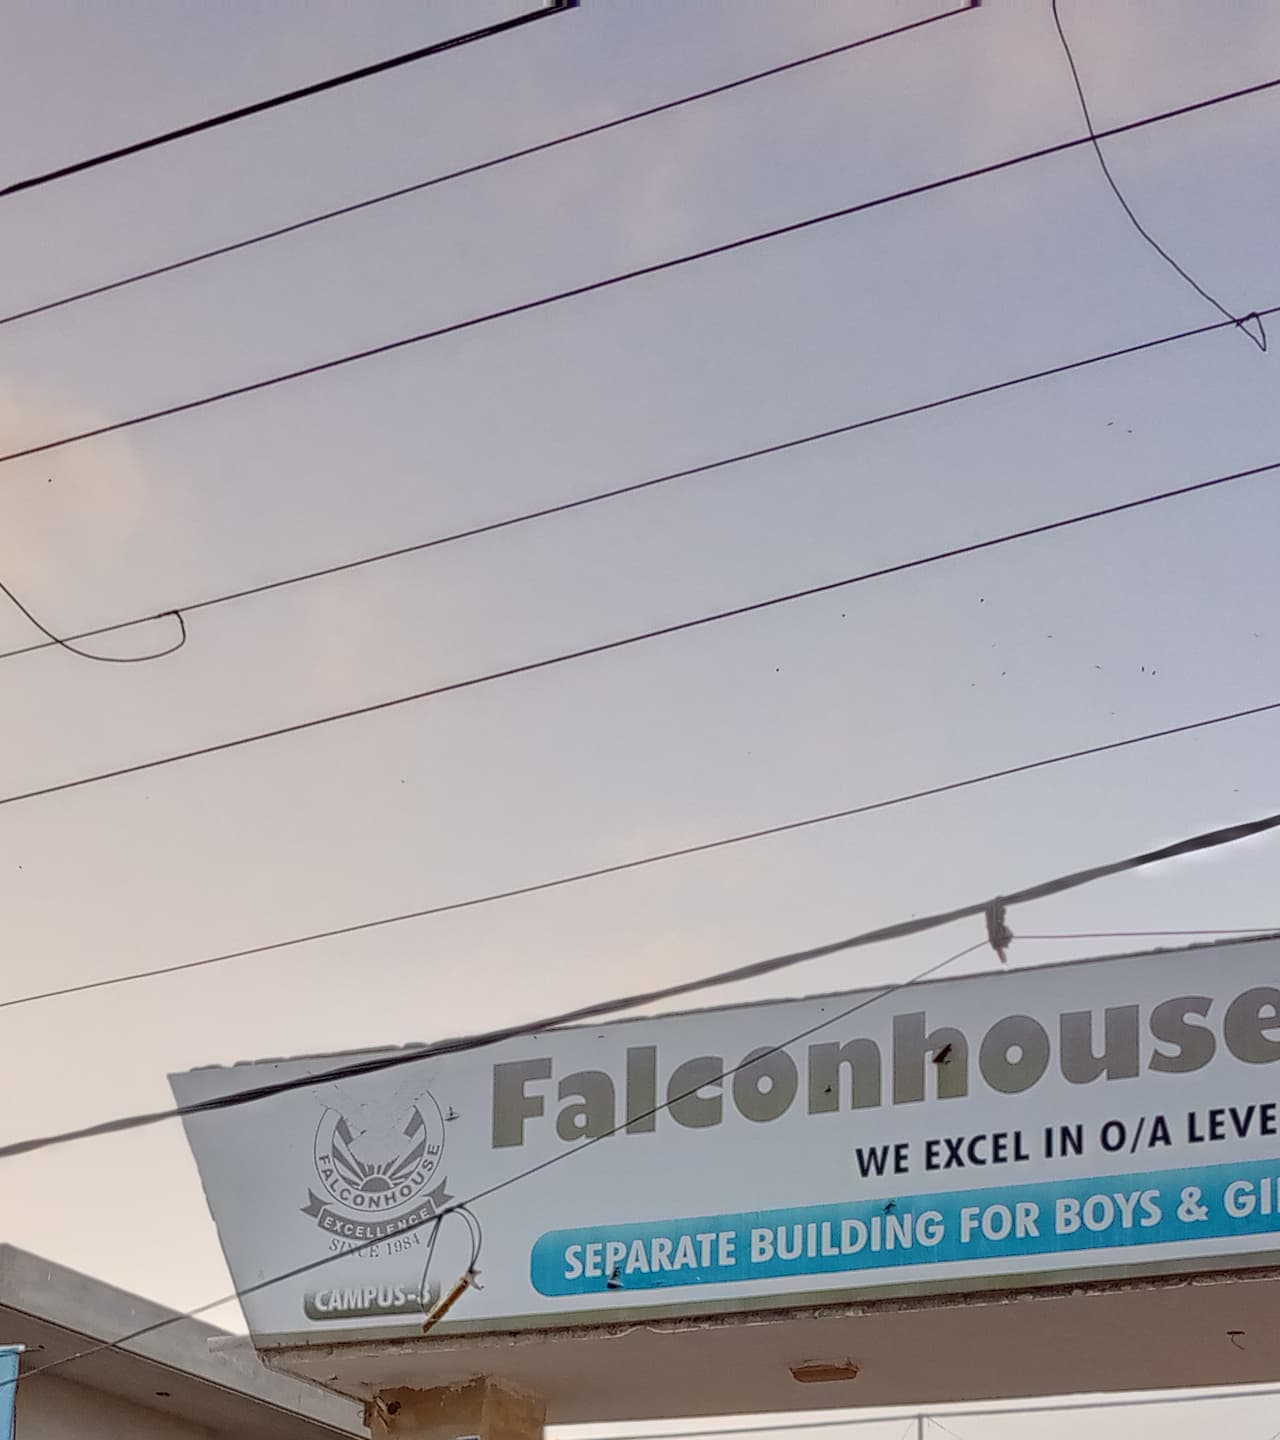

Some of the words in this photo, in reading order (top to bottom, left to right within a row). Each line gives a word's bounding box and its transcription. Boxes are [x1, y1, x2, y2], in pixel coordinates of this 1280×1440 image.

[856, 1142, 910, 1179] WE
[924, 1130, 1030, 1172] EXCEL
[1044, 1124, 1084, 1159] IN
[1100, 1111, 1172, 1157] O/A
[318, 1143, 441, 1209] FALCONHOUSE
[324, 1207, 431, 1238] EXCELLENCE
[386, 1232, 421, 1256] 1984
[563, 1230, 737, 1281] SEPARATE
[750, 1210, 946, 1265] BUILDING
[959, 1204, 1040, 1245] FOR
[1054, 1192, 1164, 1236] BOYS
[1178, 1185, 1210, 1224] &
[316, 1286, 431, 1311] CAMPUS-3
